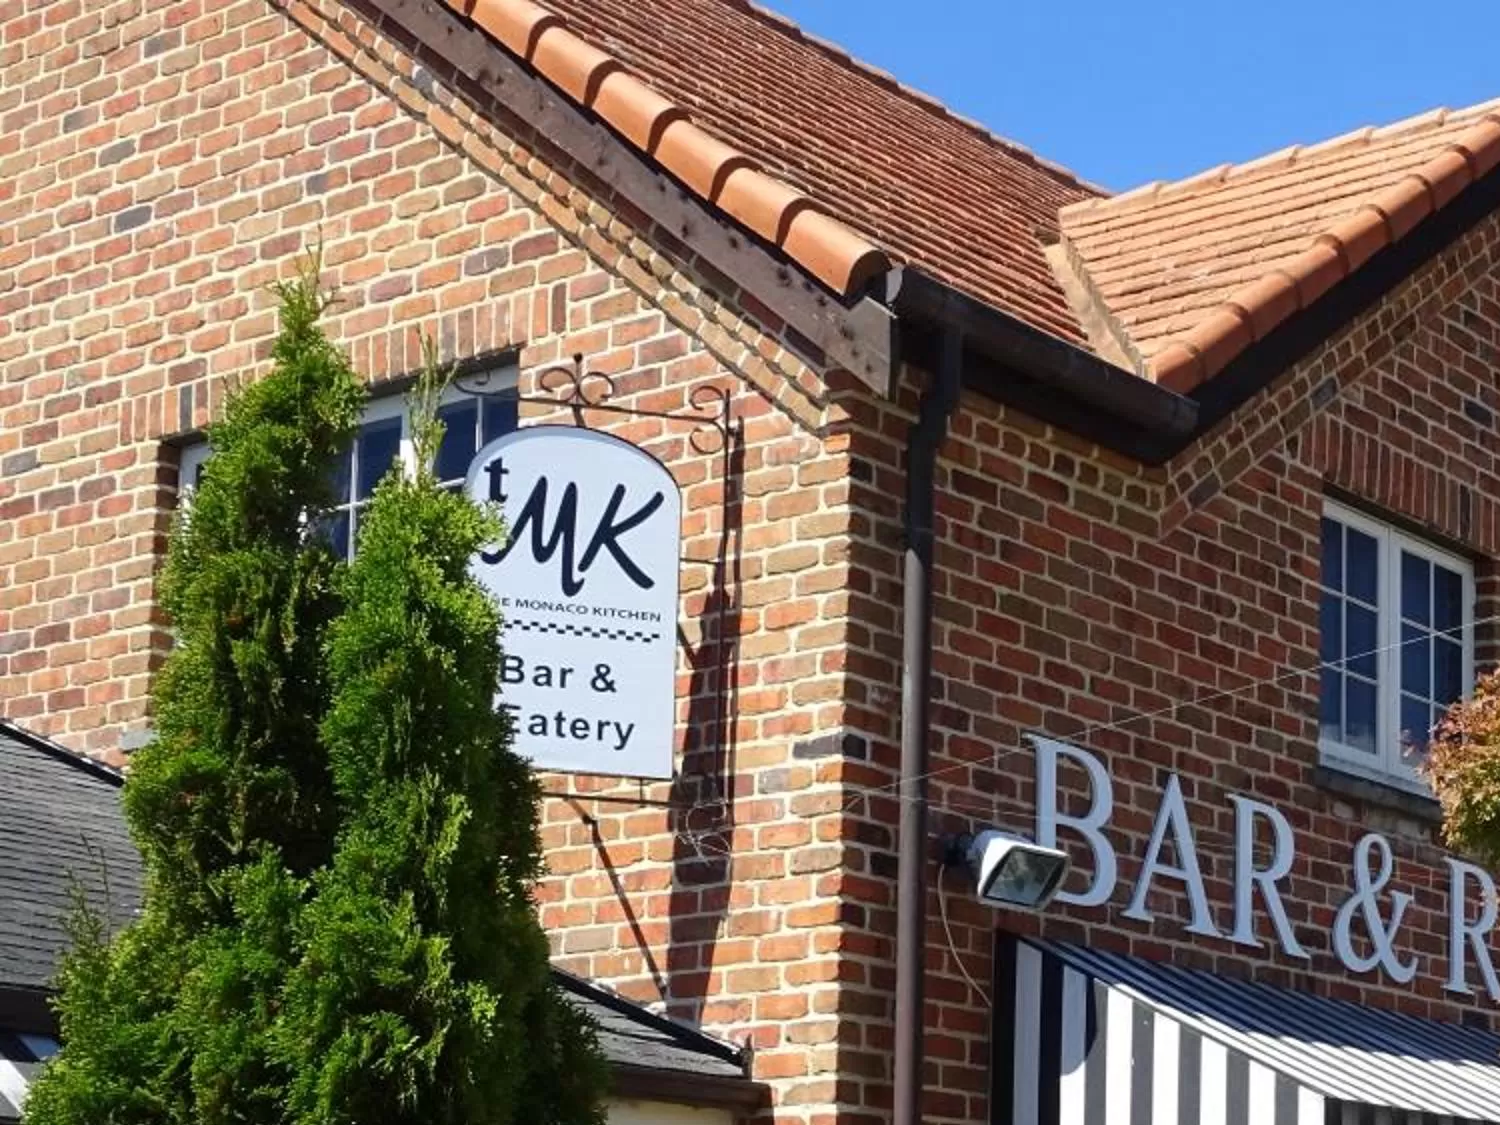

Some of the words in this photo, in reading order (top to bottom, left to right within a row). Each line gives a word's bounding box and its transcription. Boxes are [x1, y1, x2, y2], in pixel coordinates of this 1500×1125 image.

[515, 599, 589, 617] MONACO
[593, 606, 662, 623] KITCHEN
[500, 655, 575, 690] Bar
[590, 662, 618, 694] &
[1022, 731, 1312, 960] BAR
[1332, 832, 1419, 983] &
